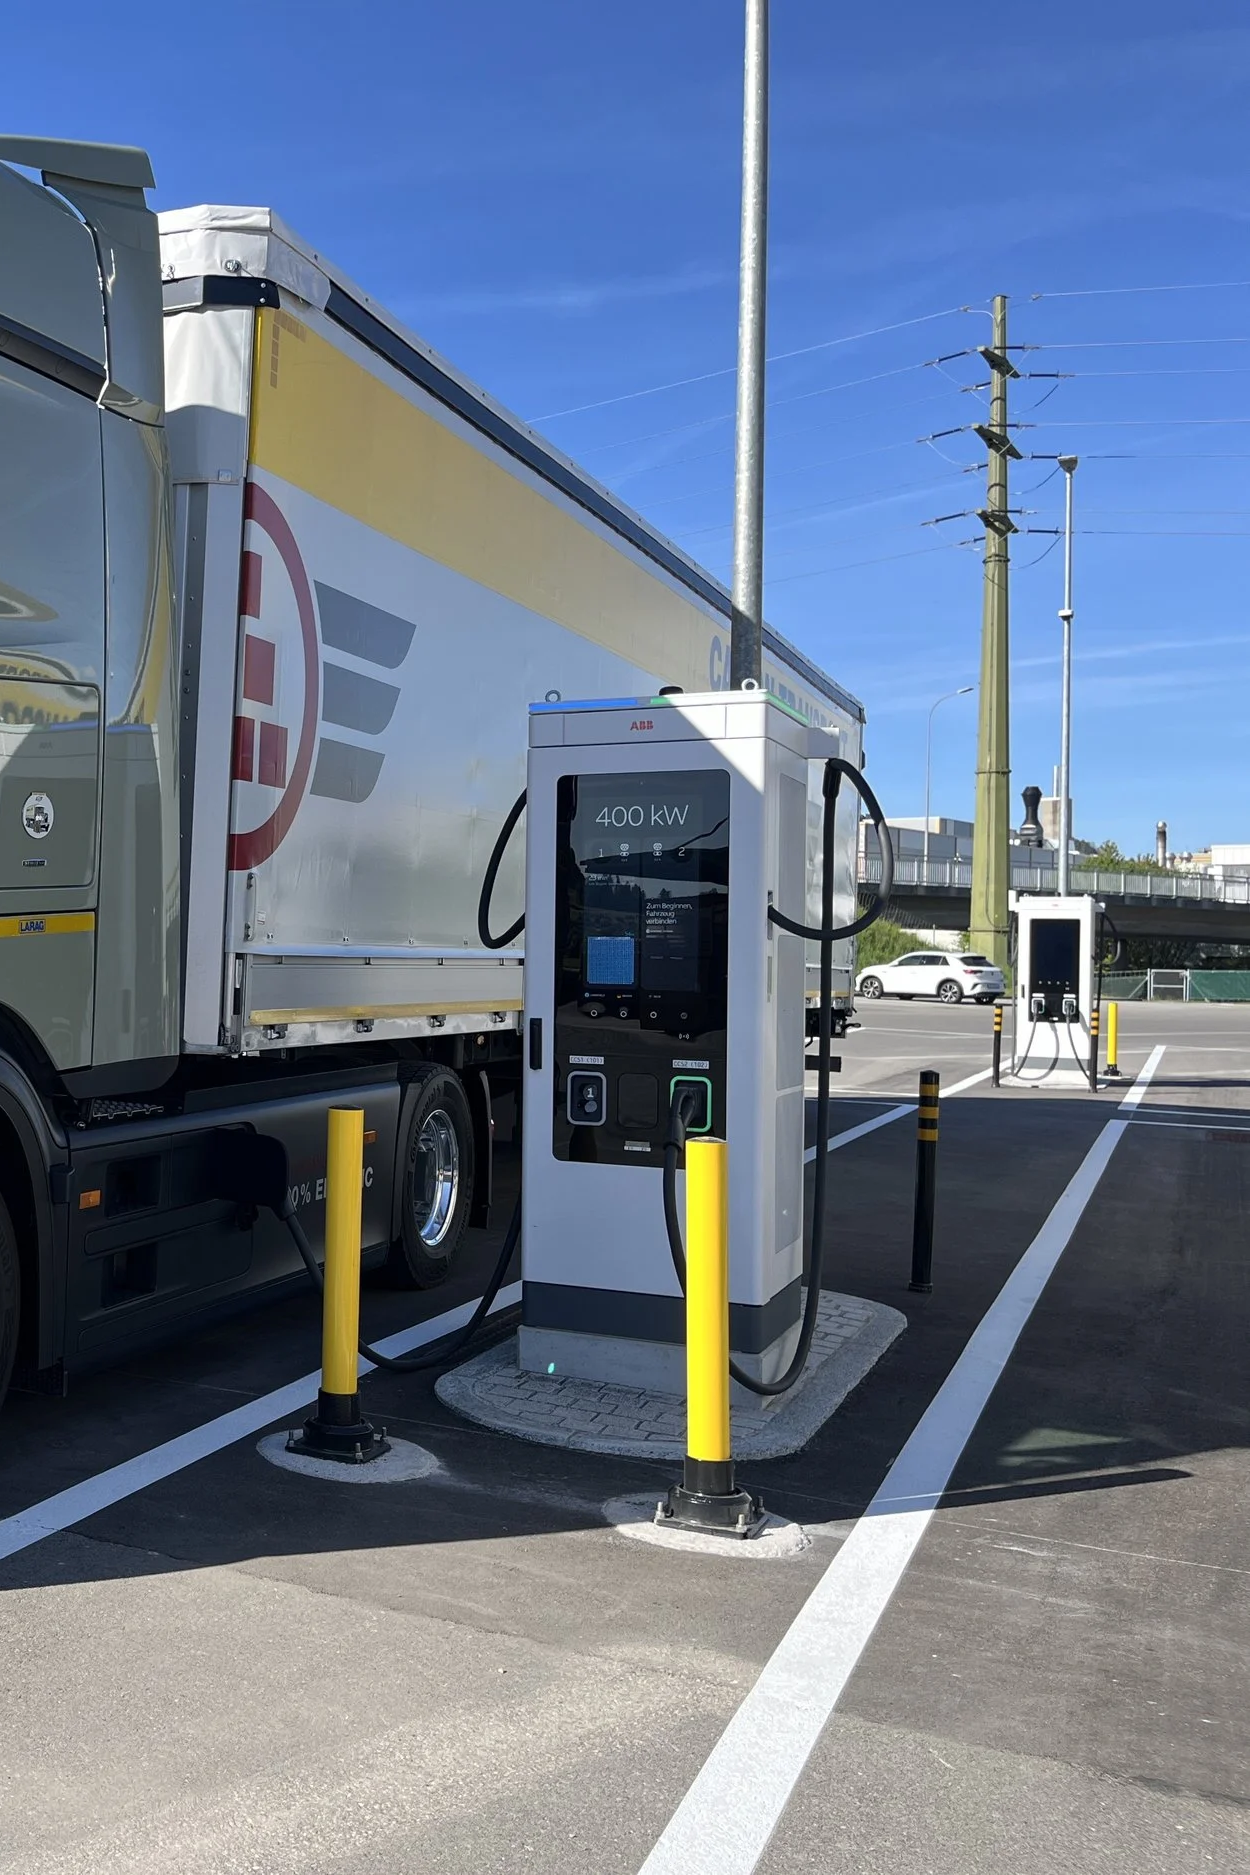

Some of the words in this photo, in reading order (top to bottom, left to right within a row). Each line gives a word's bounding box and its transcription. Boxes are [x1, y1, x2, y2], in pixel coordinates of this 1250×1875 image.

[630, 720, 654, 731] ABB
[595, 806, 644, 827] 400
[651, 804, 689, 826] kW
[598, 848, 604, 858] 1
[678, 846, 686, 857] 2
[645, 902, 661, 910] Zum
[20, 920, 45, 932] LARAG
[586, 1087, 594, 1098] 1
[287, 1181, 311, 1208] 0%
